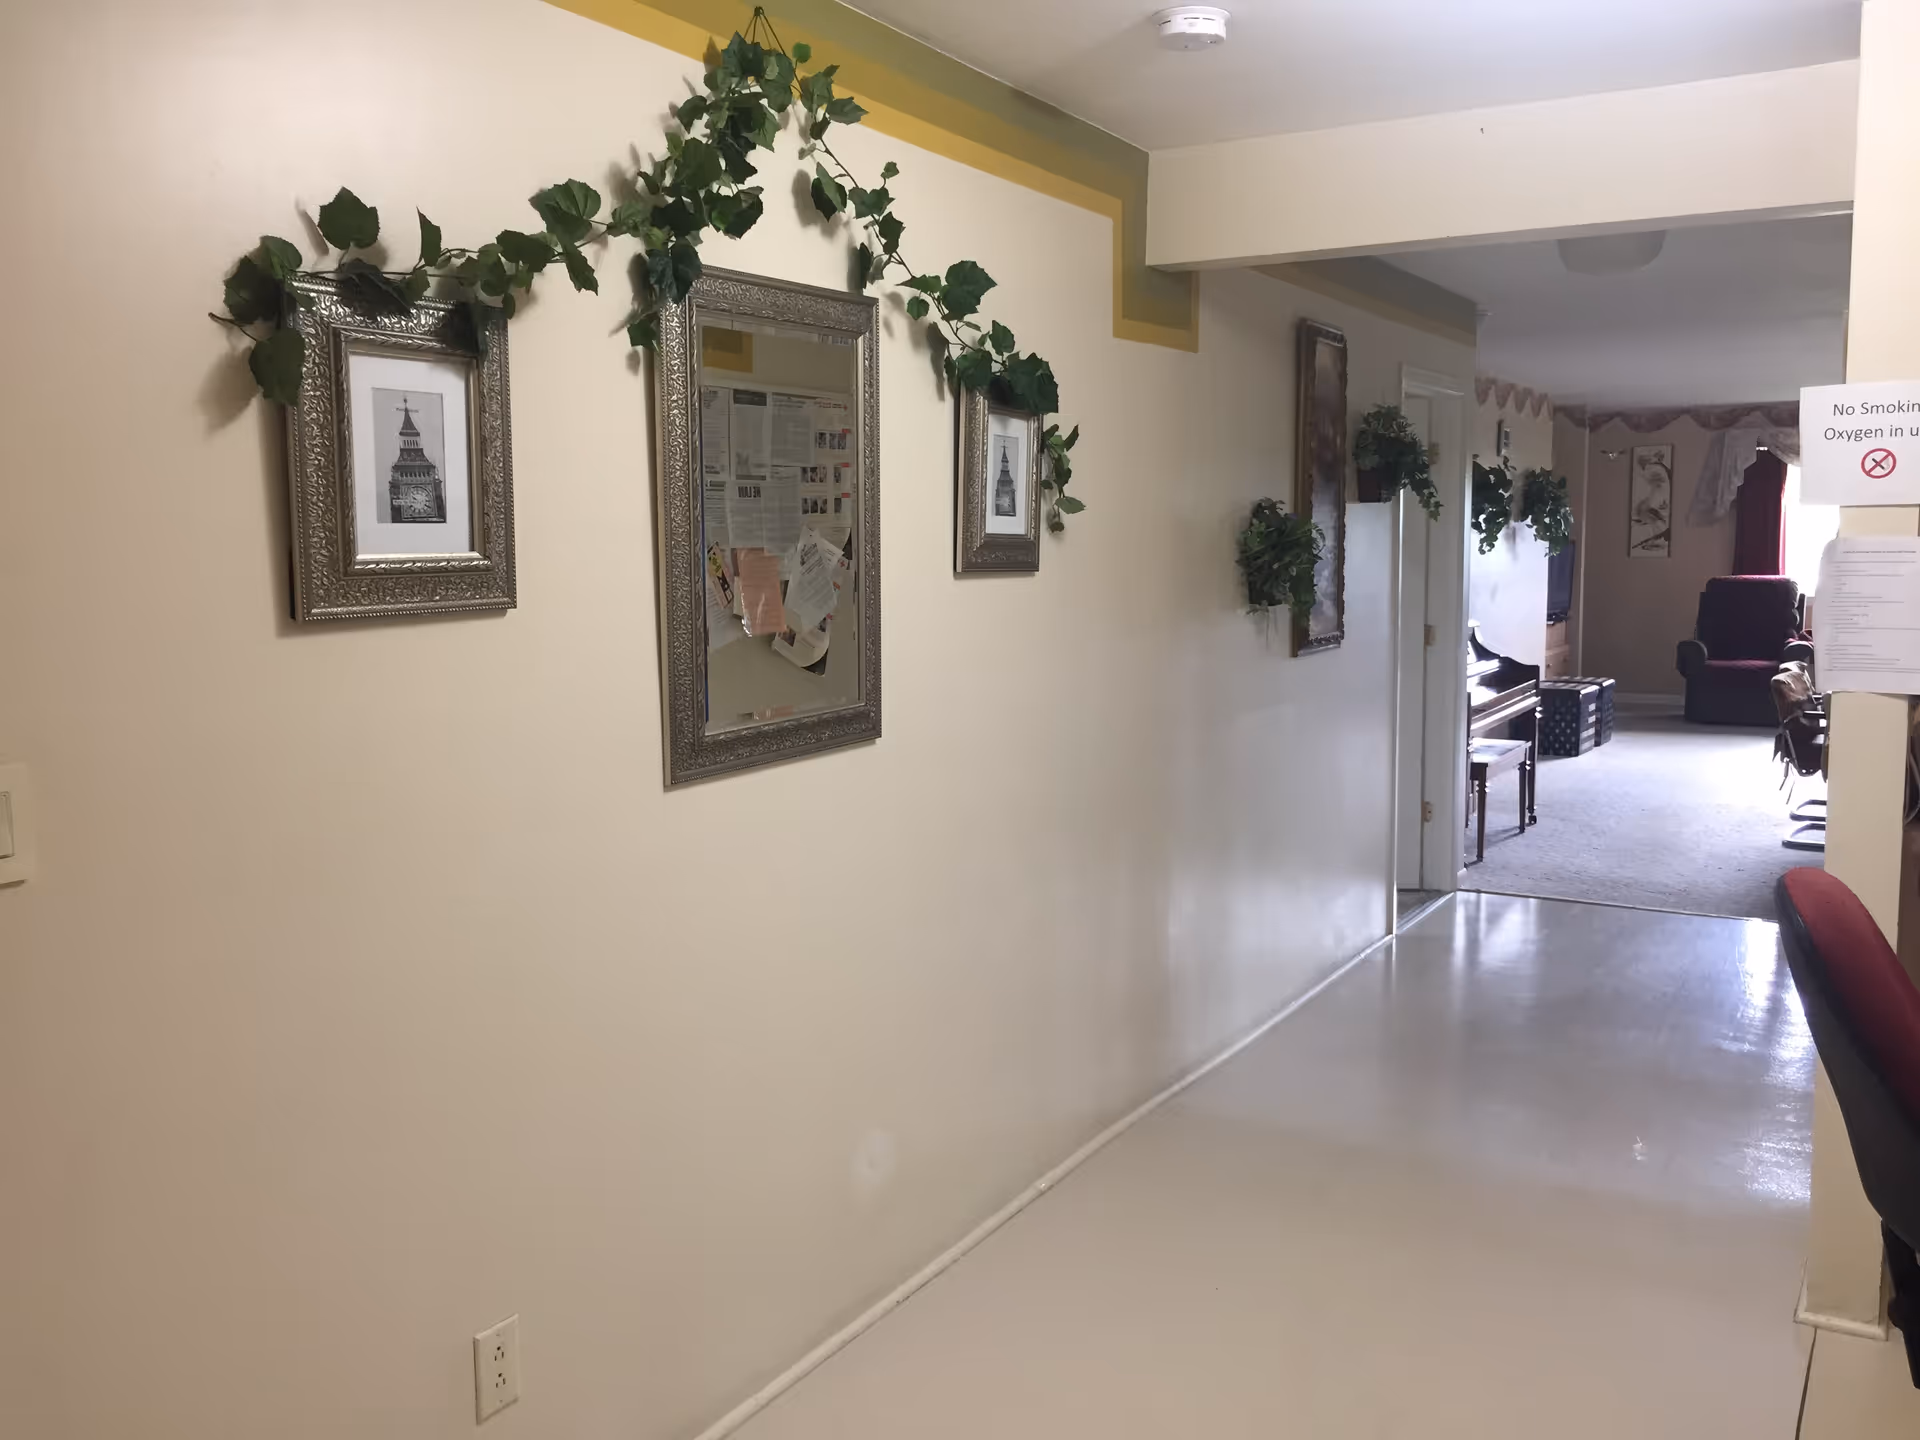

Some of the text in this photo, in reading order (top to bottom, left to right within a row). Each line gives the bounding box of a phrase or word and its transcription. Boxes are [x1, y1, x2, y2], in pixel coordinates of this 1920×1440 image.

[1833, 400, 1920, 416] No Smokin
[1824, 427, 1883, 441] Oxygen
[1889, 425, 1903, 437] in
